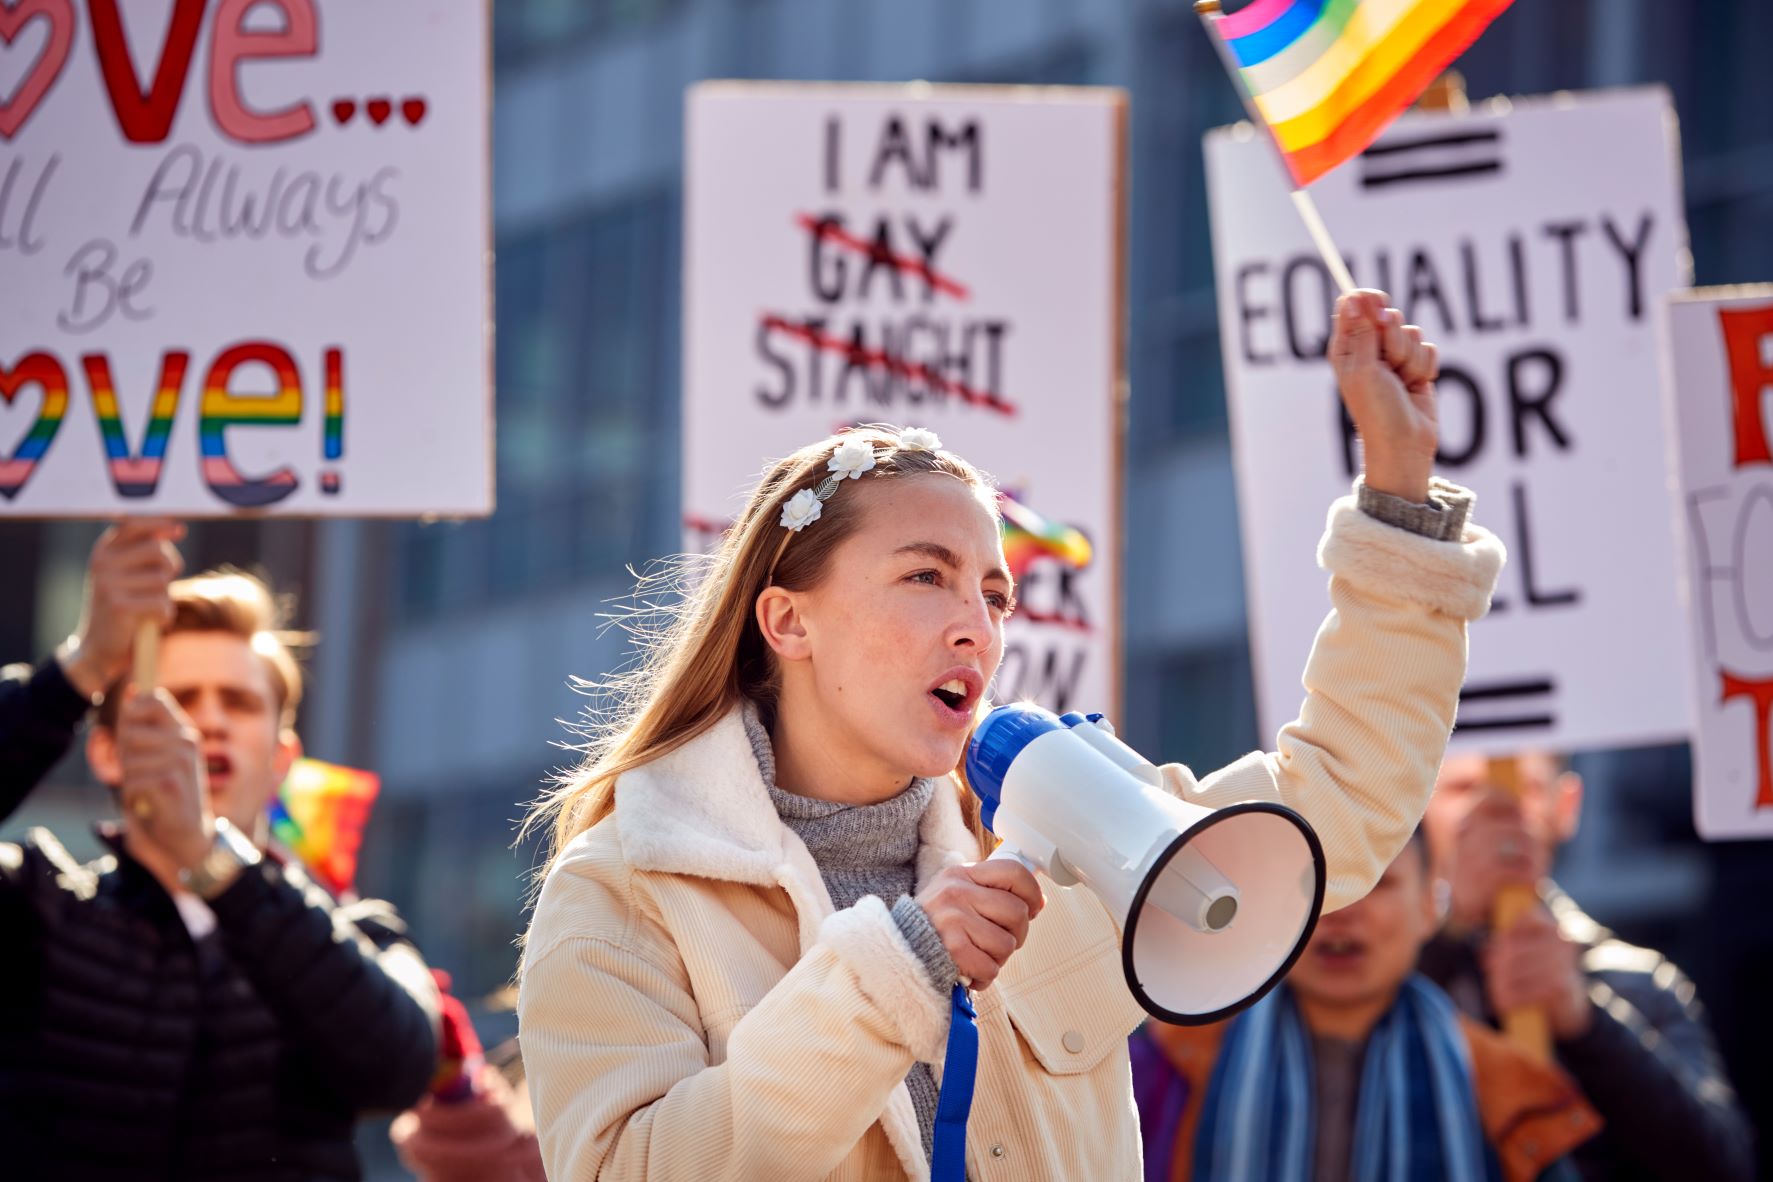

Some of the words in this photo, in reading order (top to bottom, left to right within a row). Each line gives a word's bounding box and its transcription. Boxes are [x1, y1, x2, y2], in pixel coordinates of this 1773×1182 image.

[824, 114, 842, 192] I
[868, 113, 982, 192] AM
[129, 143, 402, 281] Always
[810, 211, 954, 303] GAY
[56, 238, 157, 334] Be
